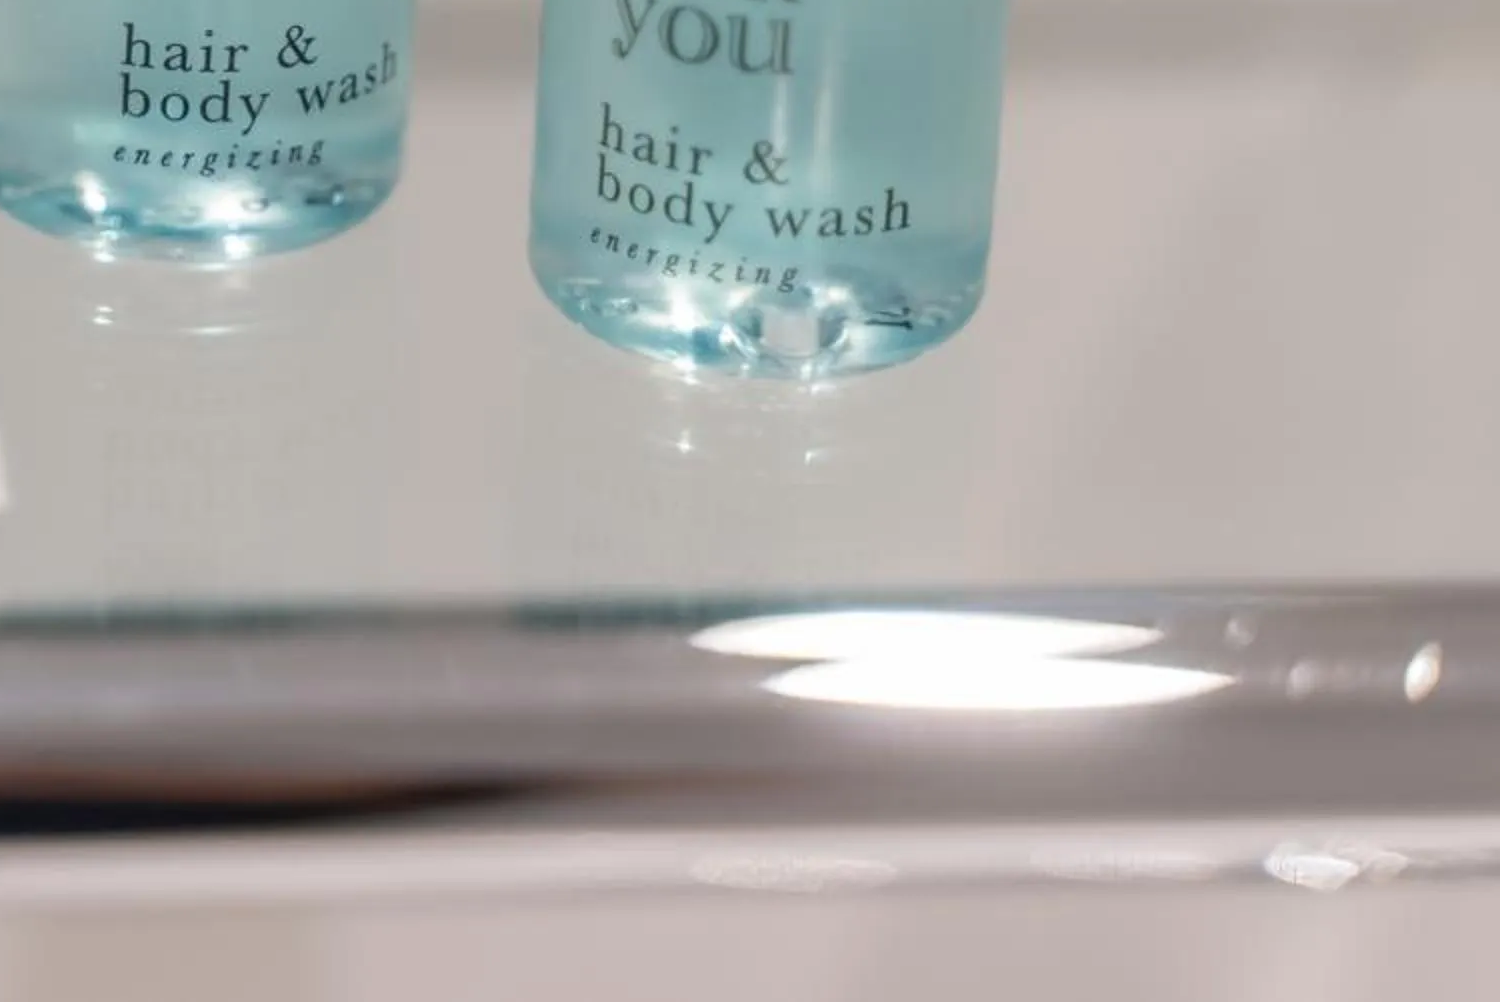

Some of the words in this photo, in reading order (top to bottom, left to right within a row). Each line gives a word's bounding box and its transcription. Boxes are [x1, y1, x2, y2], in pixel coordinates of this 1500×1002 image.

[122, 22, 249, 74] hair
[277, 24, 318, 69] &
[120, 72, 271, 135] body
[296, 41, 398, 118] wash
[113, 139, 326, 177] energizing
[598, 101, 714, 177] hair
[742, 140, 790, 185] &
[596, 153, 734, 243] body
[766, 187, 912, 239] wash
[589, 226, 799, 294] energizing
